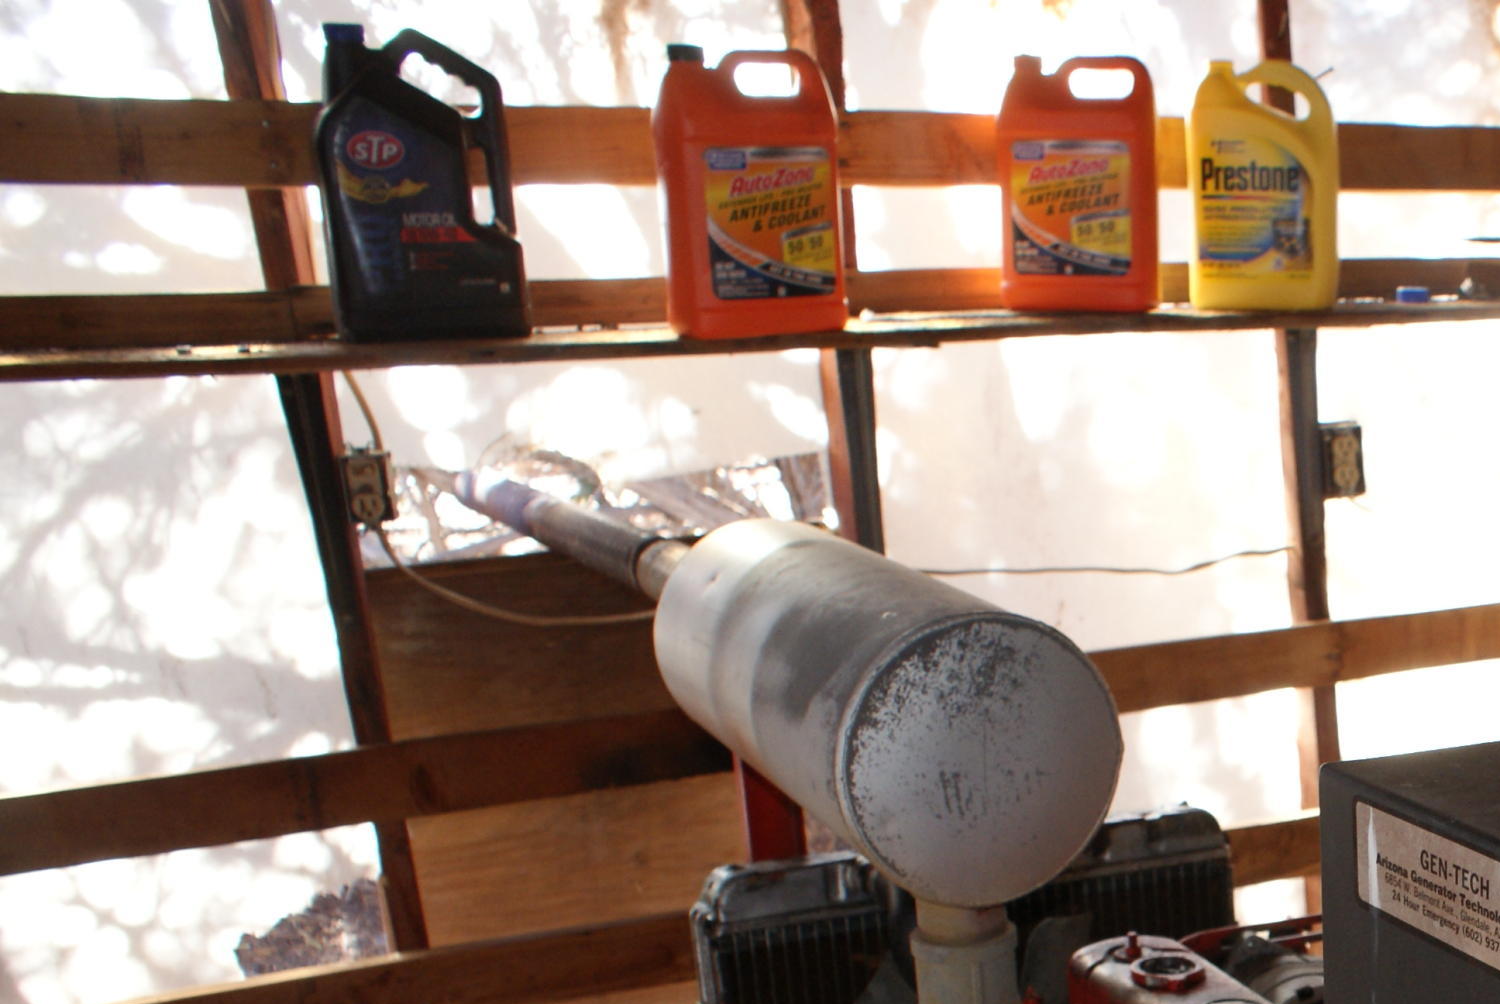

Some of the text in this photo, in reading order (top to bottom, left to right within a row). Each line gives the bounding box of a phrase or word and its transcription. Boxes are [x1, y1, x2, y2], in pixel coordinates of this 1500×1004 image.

[354, 135, 398, 164] STP
[730, 167, 815, 196] AutoZone
[1201, 157, 1299, 193] Prestone
[729, 193, 812, 222] ANTIFREEZE
[768, 204, 826, 229] COOLANT
[1376, 852, 1409, 878] Arizona
[1411, 870, 1457, 902] Generator
[1420, 849, 1490, 900] GEN-TECH
[1403, 895, 1420, 912] Hour
[1422, 904, 1459, 935] Emergency
[1462, 924, 1483, 945] (602)
